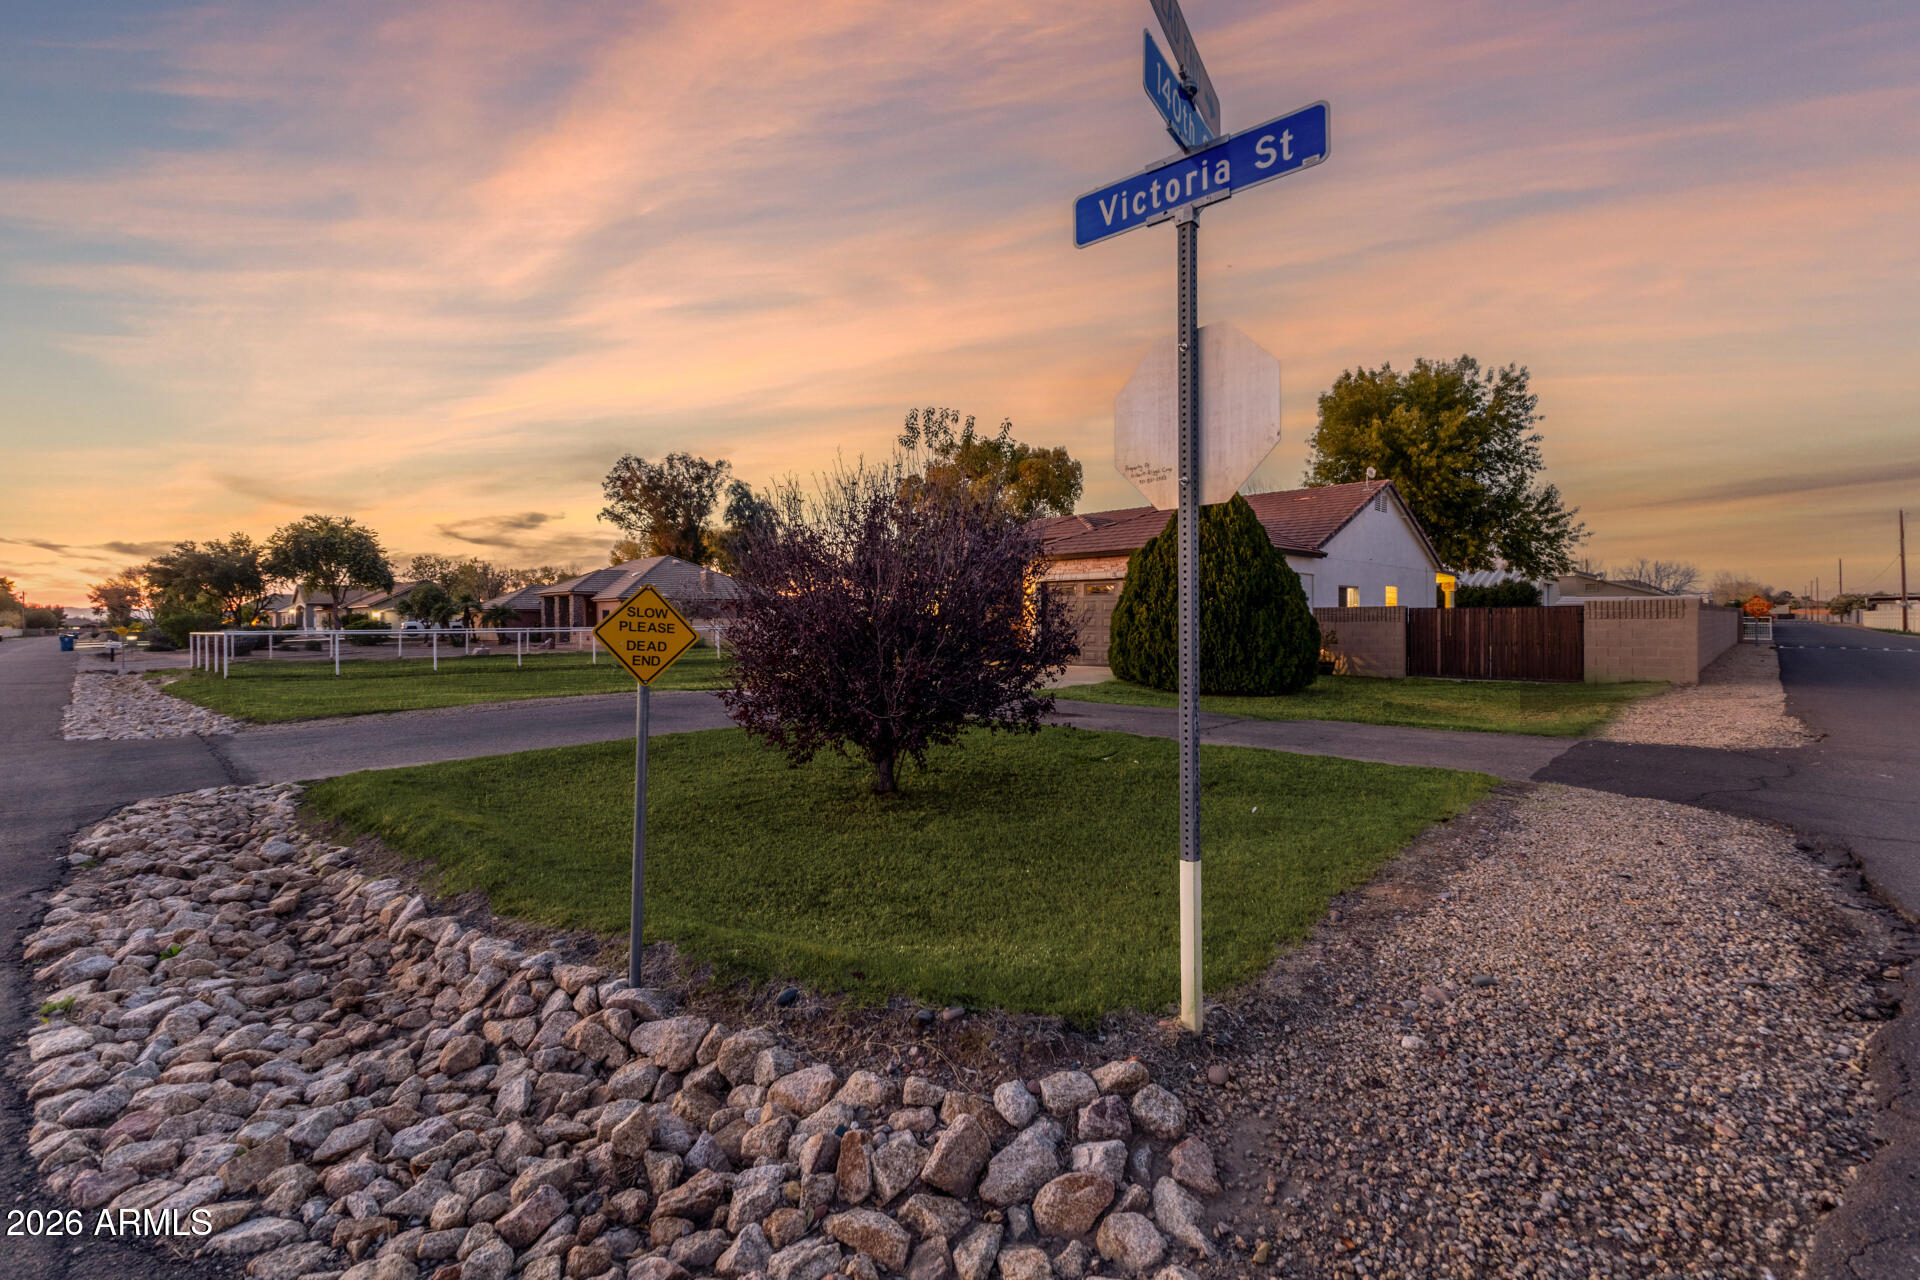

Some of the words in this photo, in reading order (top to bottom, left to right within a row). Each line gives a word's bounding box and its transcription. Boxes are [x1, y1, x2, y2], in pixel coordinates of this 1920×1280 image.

[1157, 62, 1195, 145] 140th
[1098, 159, 1231, 227] Victoria
[1254, 128, 1294, 169] St
[627, 606, 668, 619] SLOW
[619, 620, 675, 634] PLEASE
[626, 640, 667, 652] DEAD
[632, 655, 661, 667] END
